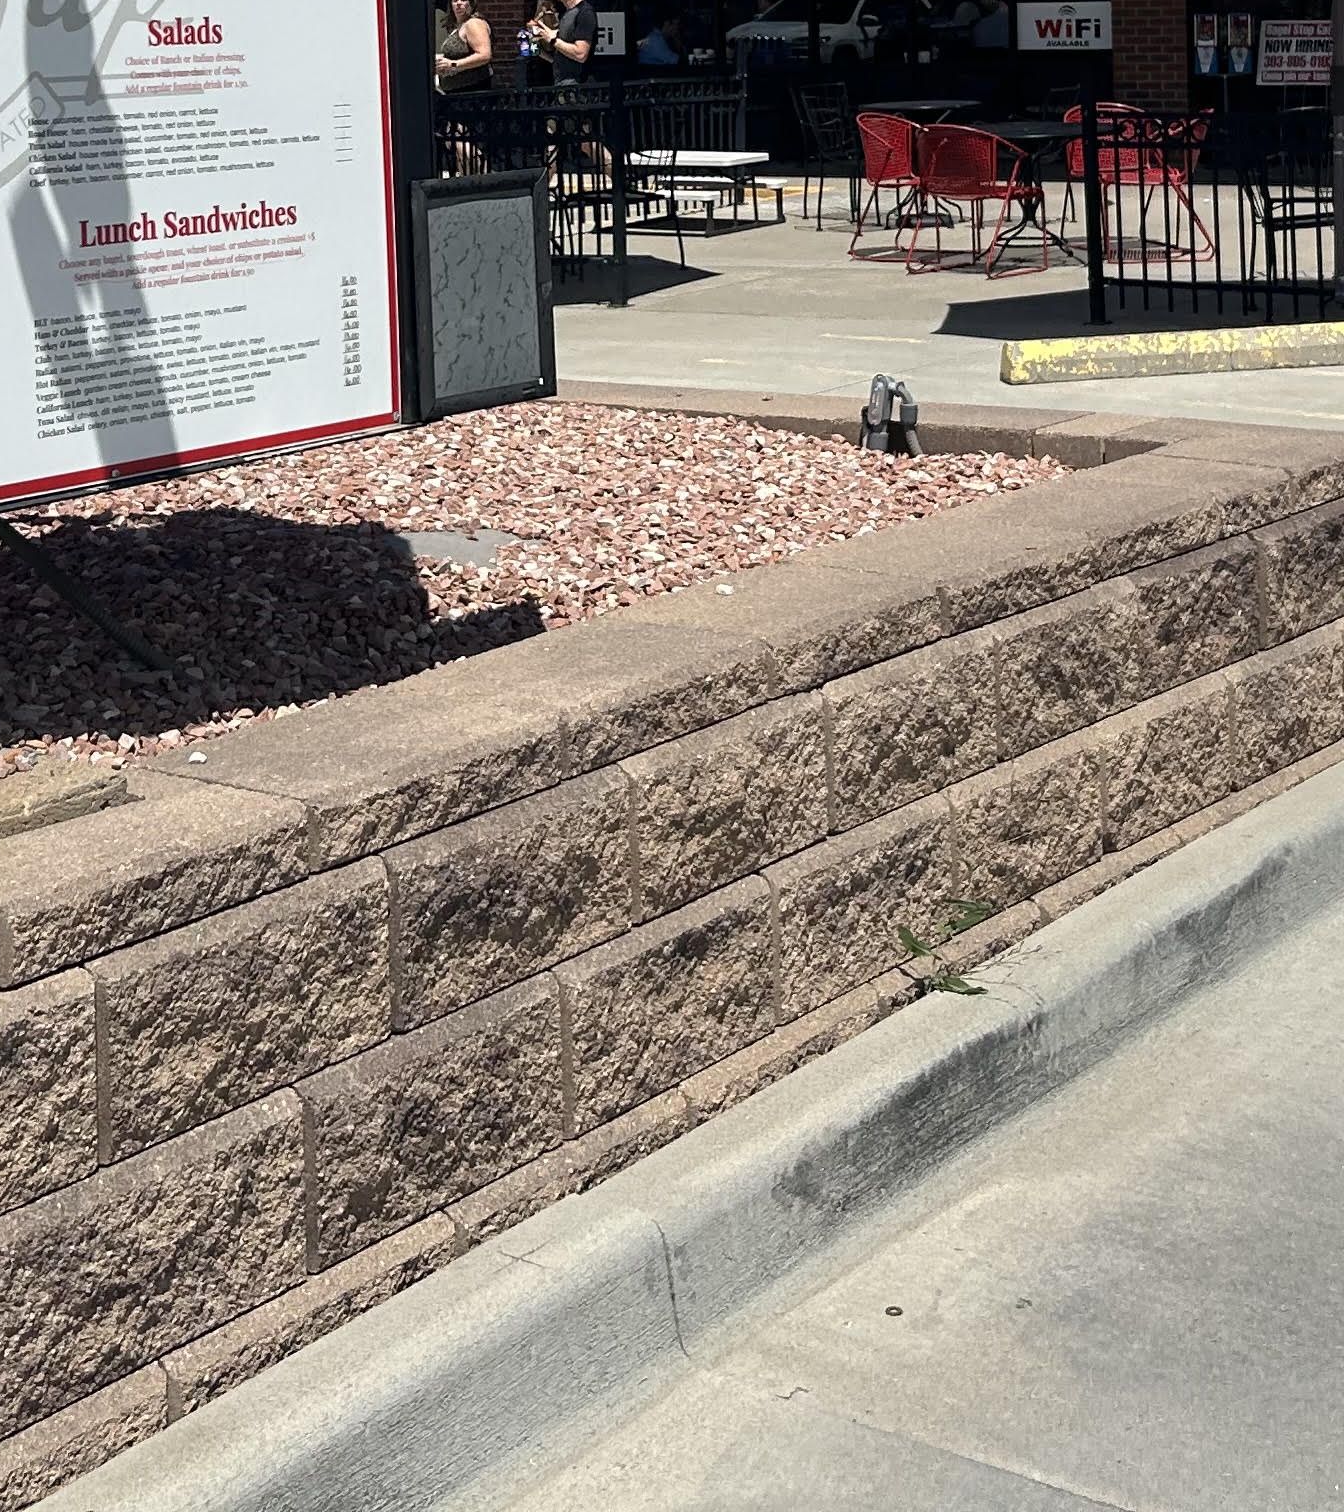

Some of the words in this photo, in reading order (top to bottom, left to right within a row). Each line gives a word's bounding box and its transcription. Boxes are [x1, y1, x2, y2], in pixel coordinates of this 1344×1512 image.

[147, 16, 223, 46] Salads
[1034, 18, 1101, 39] WiFi
[1264, 39, 1293, 52] NOW
[79, 212, 158, 247] Lunch
[163, 201, 297, 238] Sandwiches
